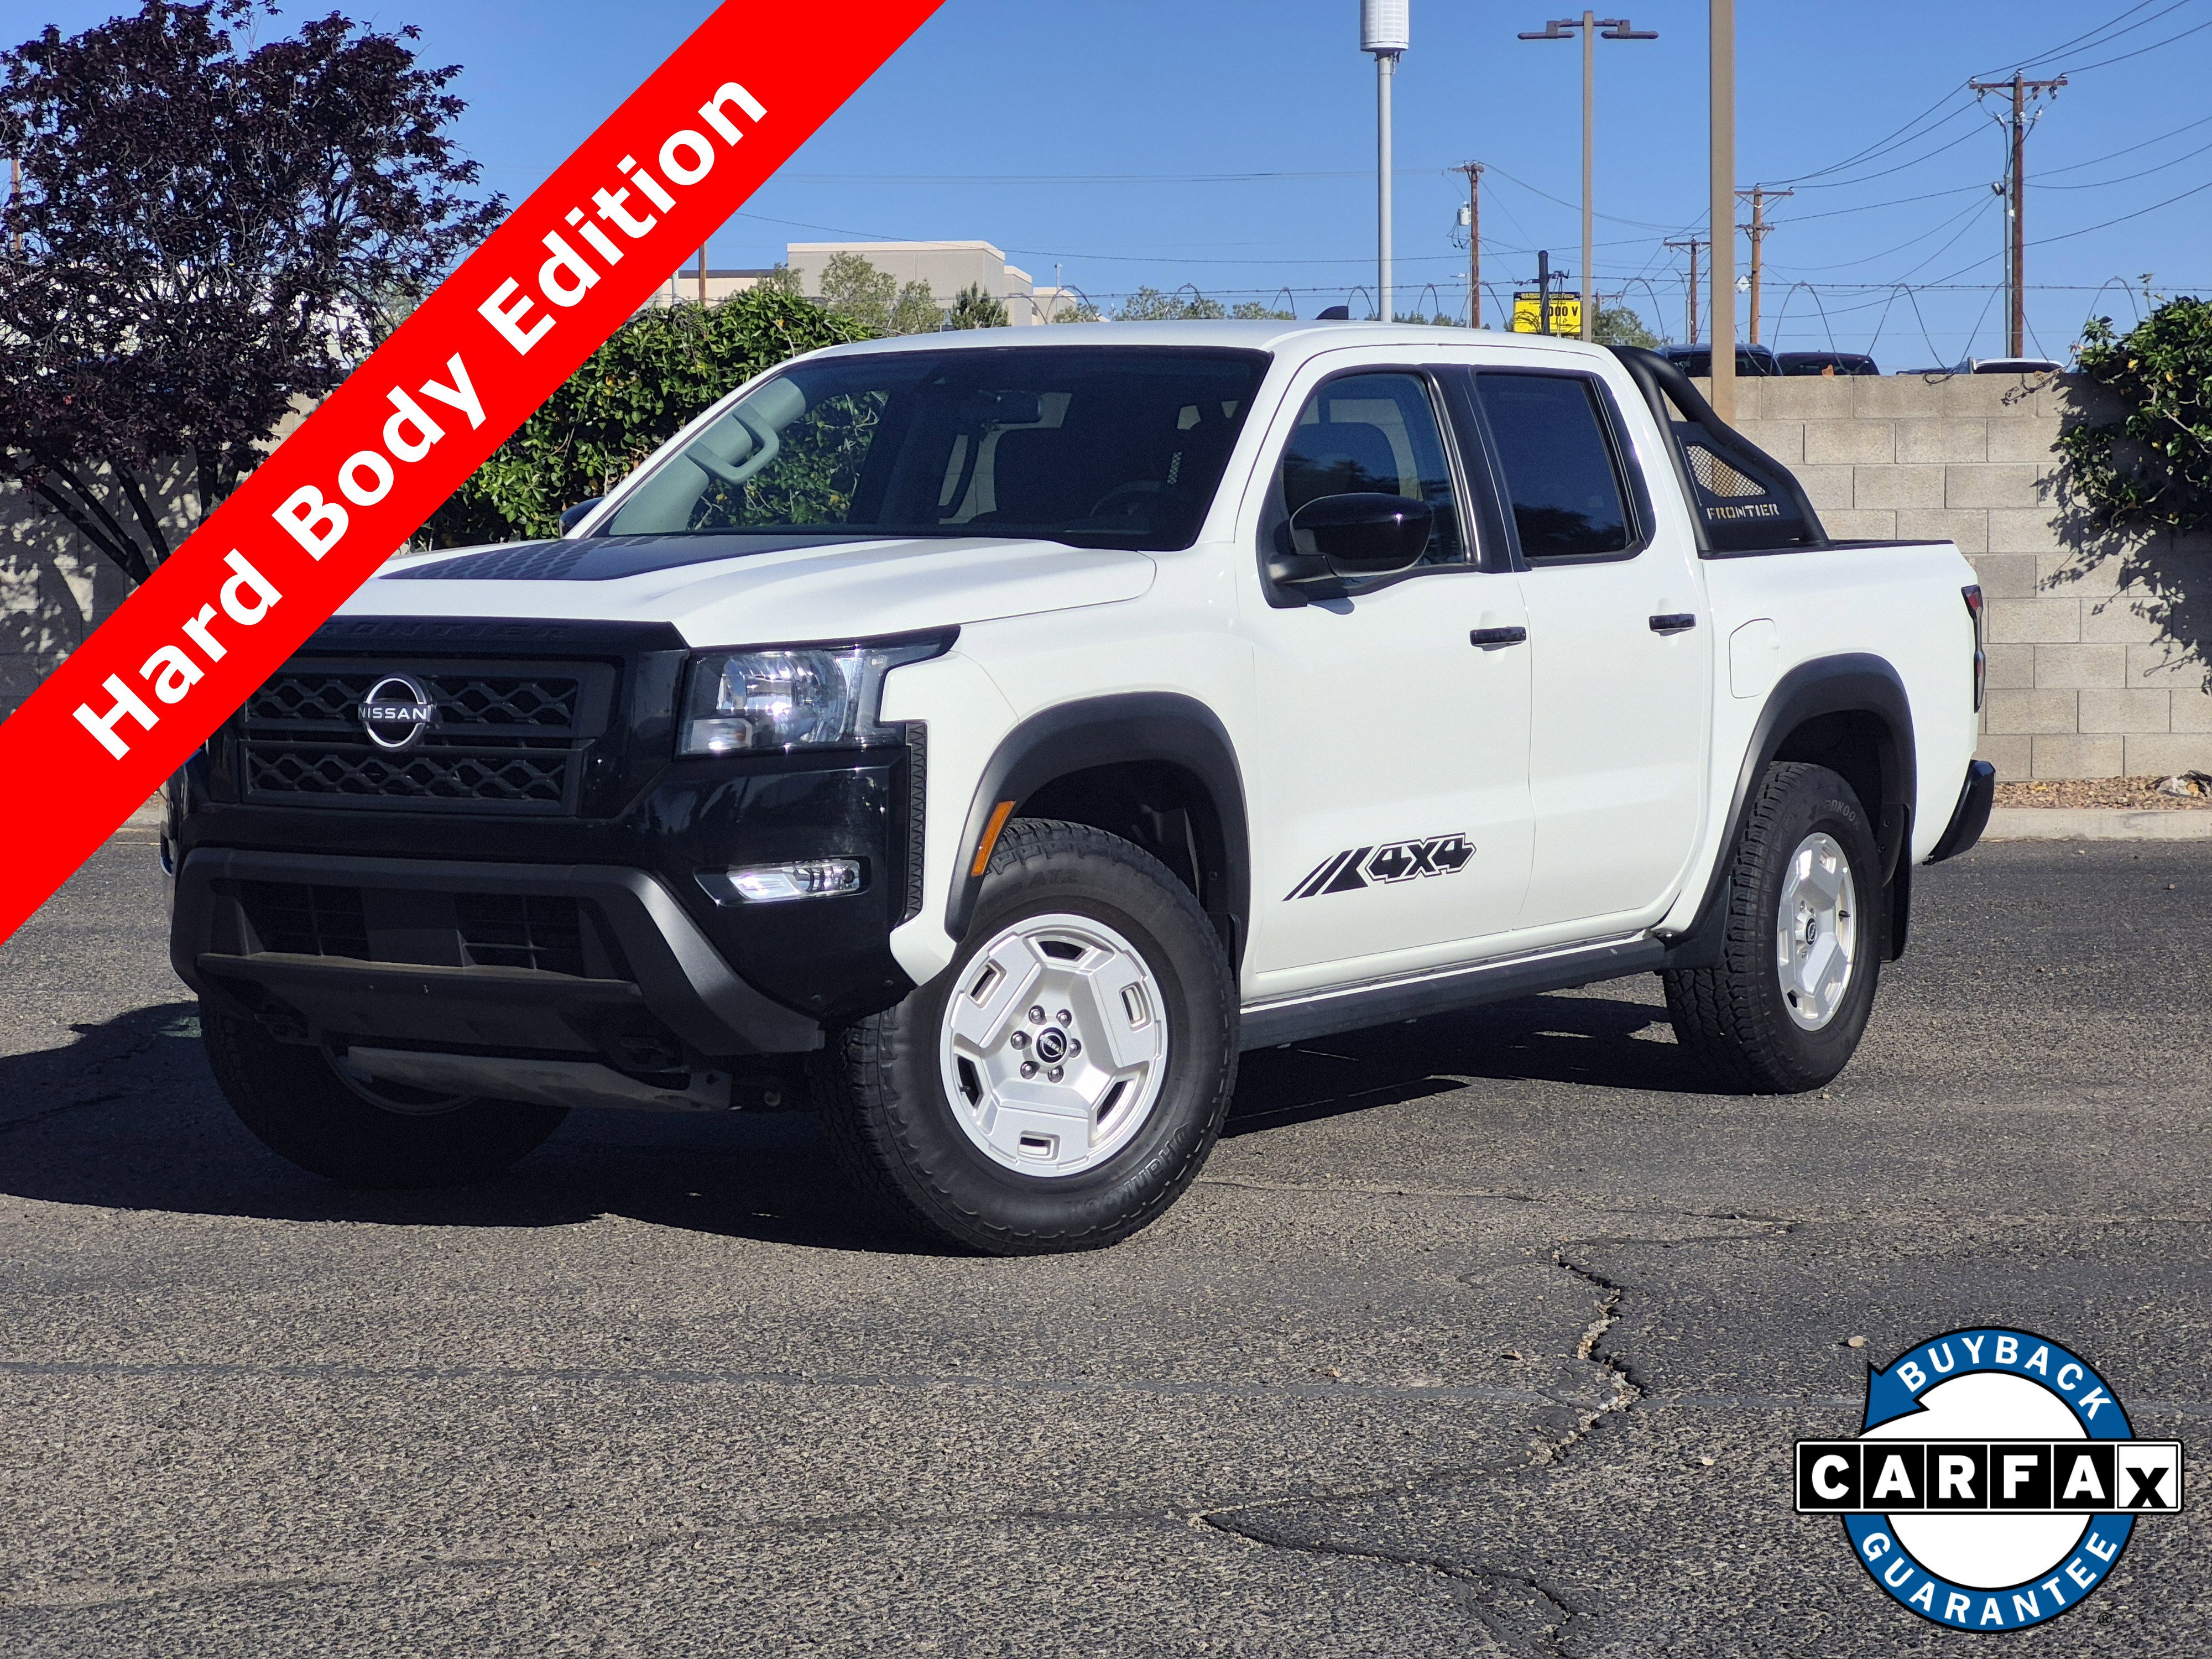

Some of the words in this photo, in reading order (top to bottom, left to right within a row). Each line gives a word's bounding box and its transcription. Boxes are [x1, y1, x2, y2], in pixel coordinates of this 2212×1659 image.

[1571, 306, 1579, 317] V
[1706, 503, 1780, 520] FRONTIER
[317, 620, 567, 639] RONTIER
[358, 707, 427, 720] NISSAN
